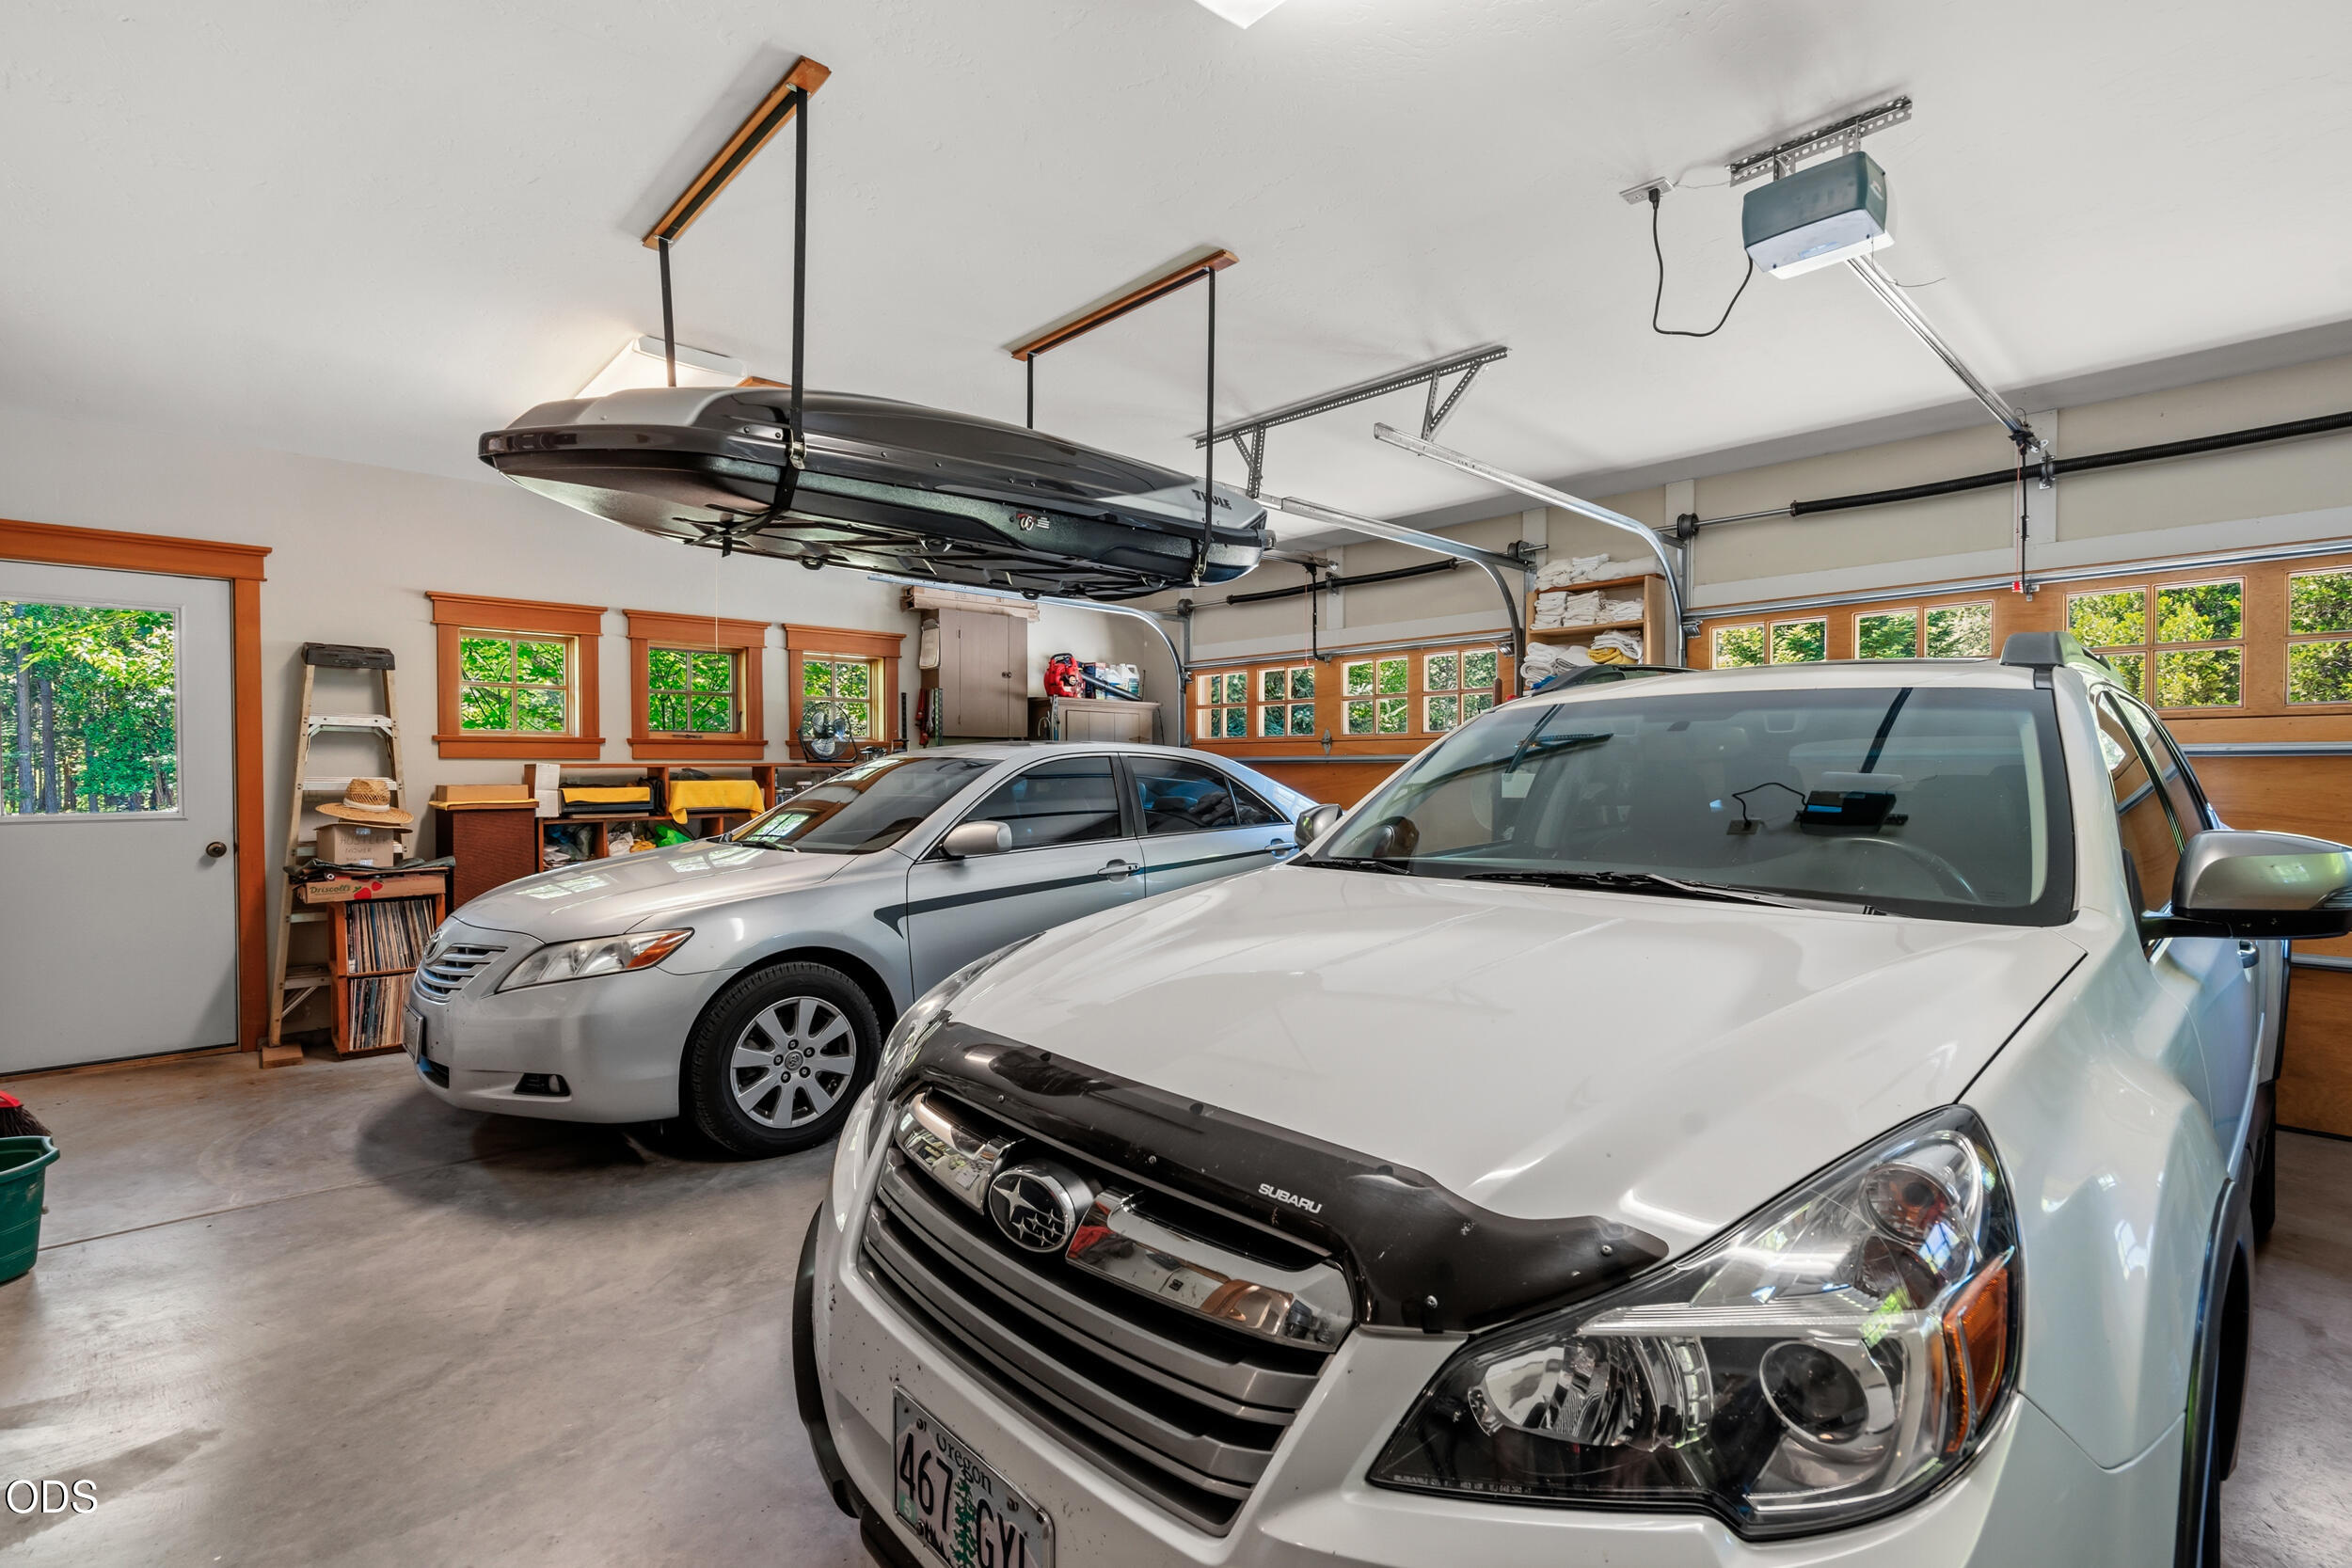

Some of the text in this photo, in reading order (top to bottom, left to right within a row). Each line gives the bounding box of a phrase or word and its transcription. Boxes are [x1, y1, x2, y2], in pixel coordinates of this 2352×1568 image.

[1257, 1182, 1323, 1214] SUBARU
[899, 1433, 953, 1533] 467
[936, 1433, 994, 1498] Oregon
